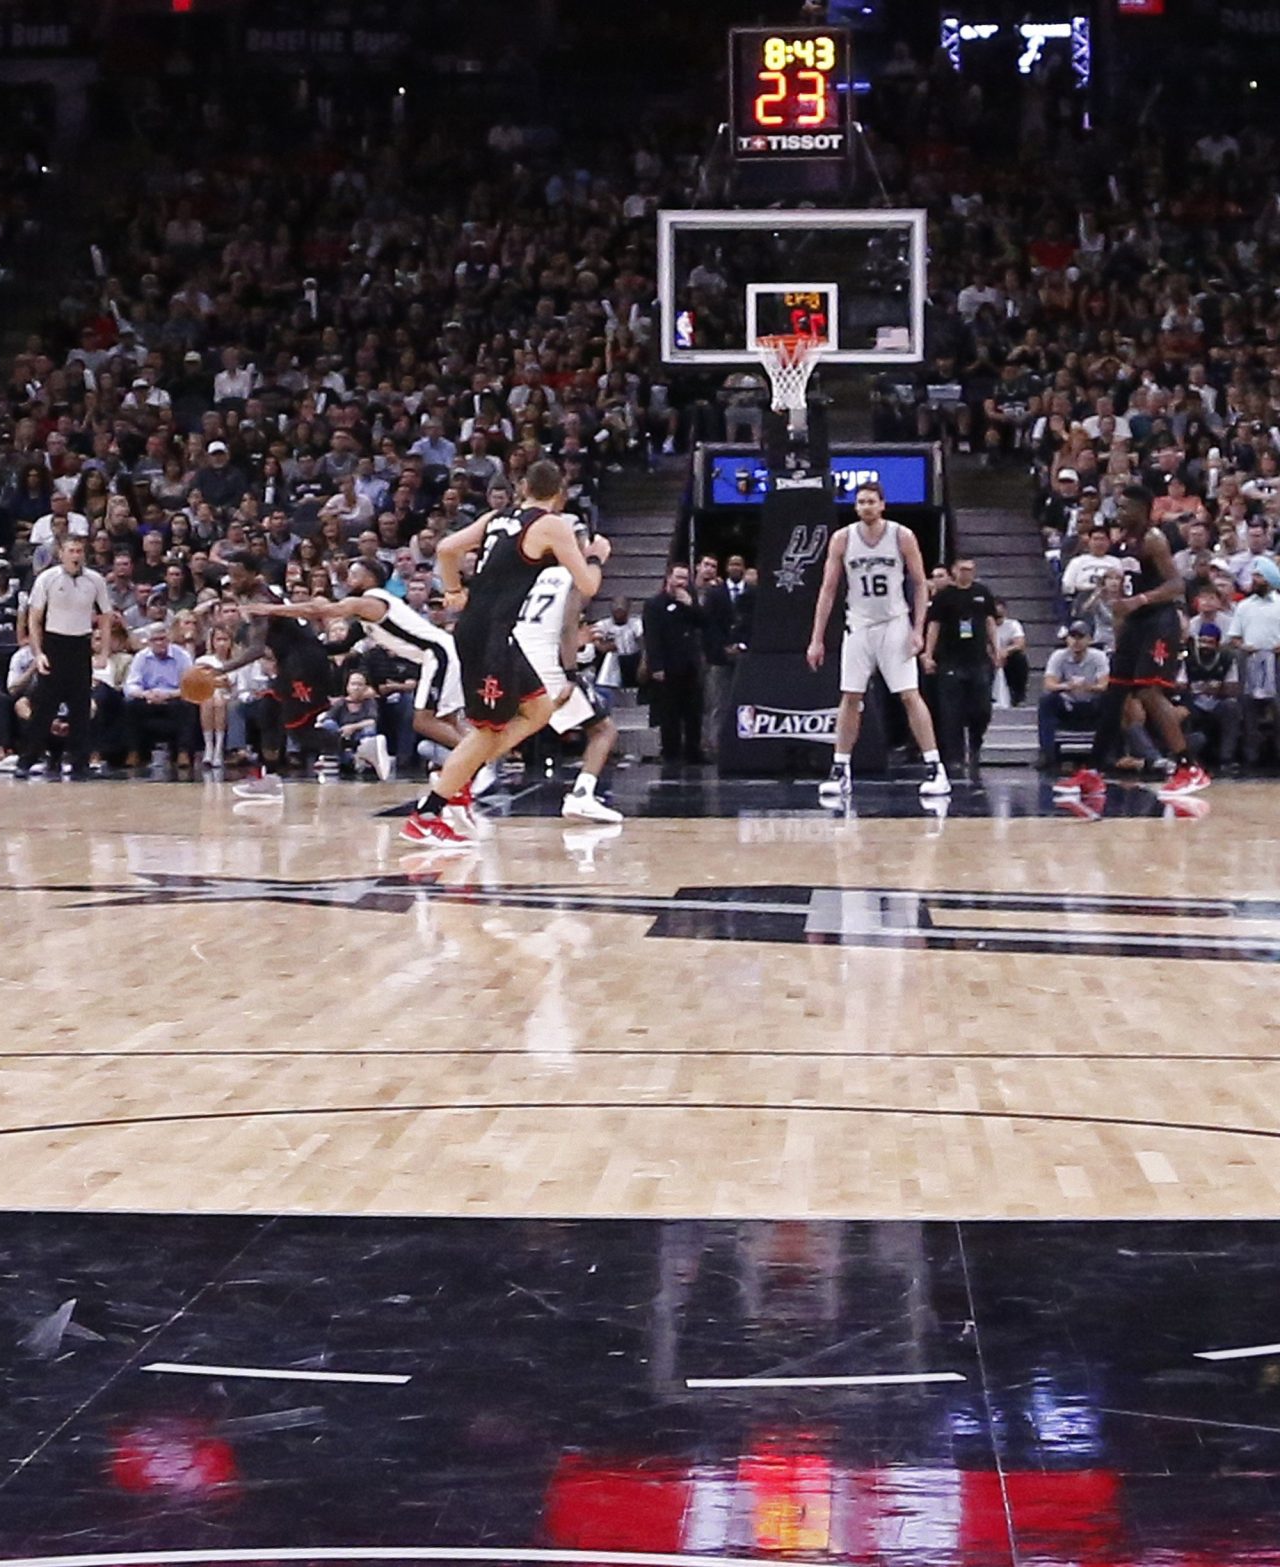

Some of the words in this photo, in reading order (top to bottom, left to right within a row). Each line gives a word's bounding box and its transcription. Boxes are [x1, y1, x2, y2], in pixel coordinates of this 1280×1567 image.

[764, 37, 835, 71] 8:43
[755, 71, 825, 125] 23
[767, 135, 844, 150] TISSOT
[860, 574, 888, 597] 16
[517, 594, 556, 623] 17
[754, 714, 838, 734] PLAYOF
